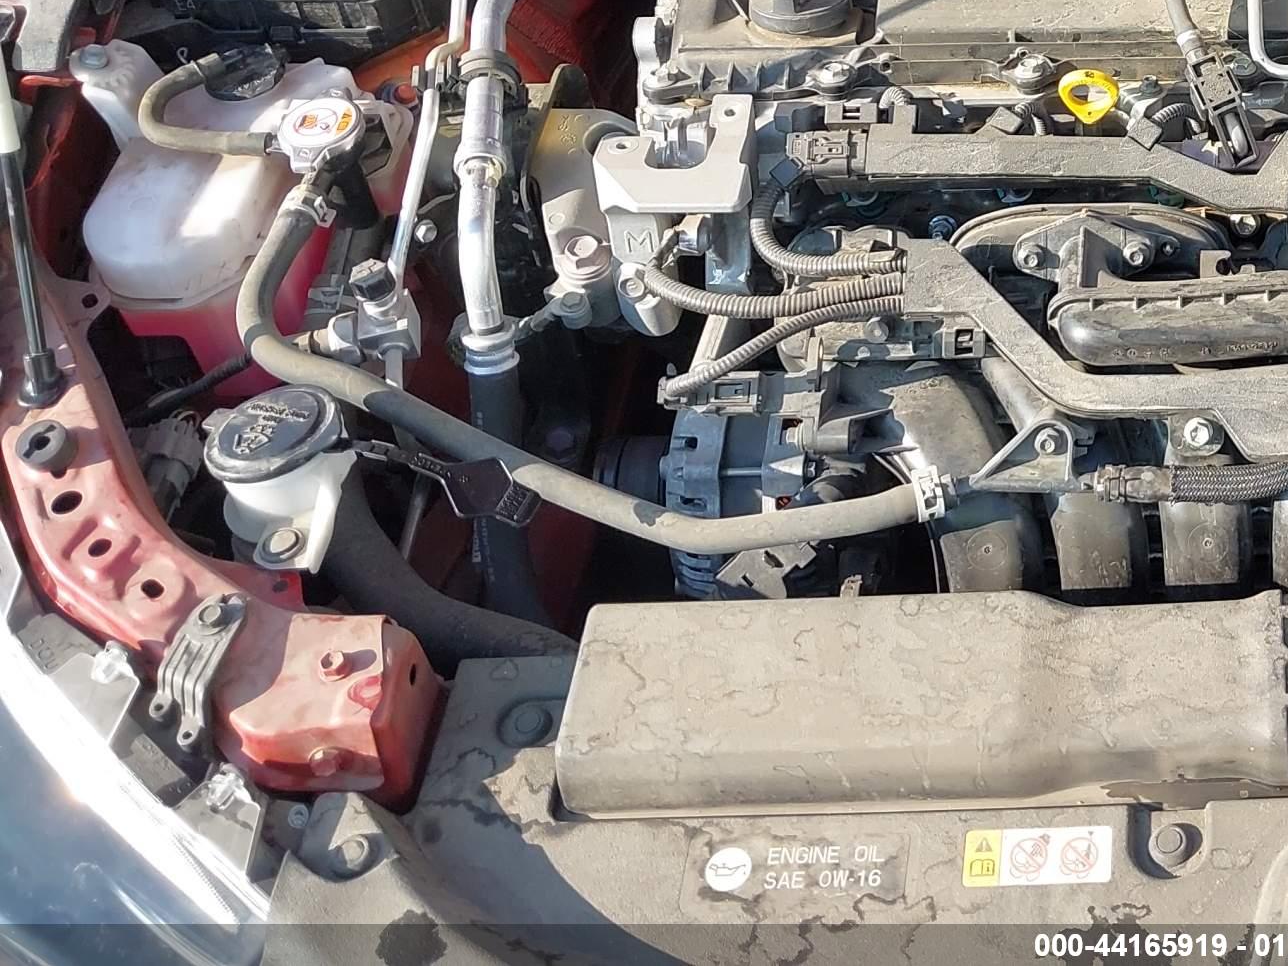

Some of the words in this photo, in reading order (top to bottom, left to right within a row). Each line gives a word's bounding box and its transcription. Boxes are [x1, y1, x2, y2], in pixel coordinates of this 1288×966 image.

[623, 230, 655, 253] M
[768, 846, 840, 863] ENGINE
[855, 845, 884, 863] OIL
[764, 872, 805, 889] SAE
